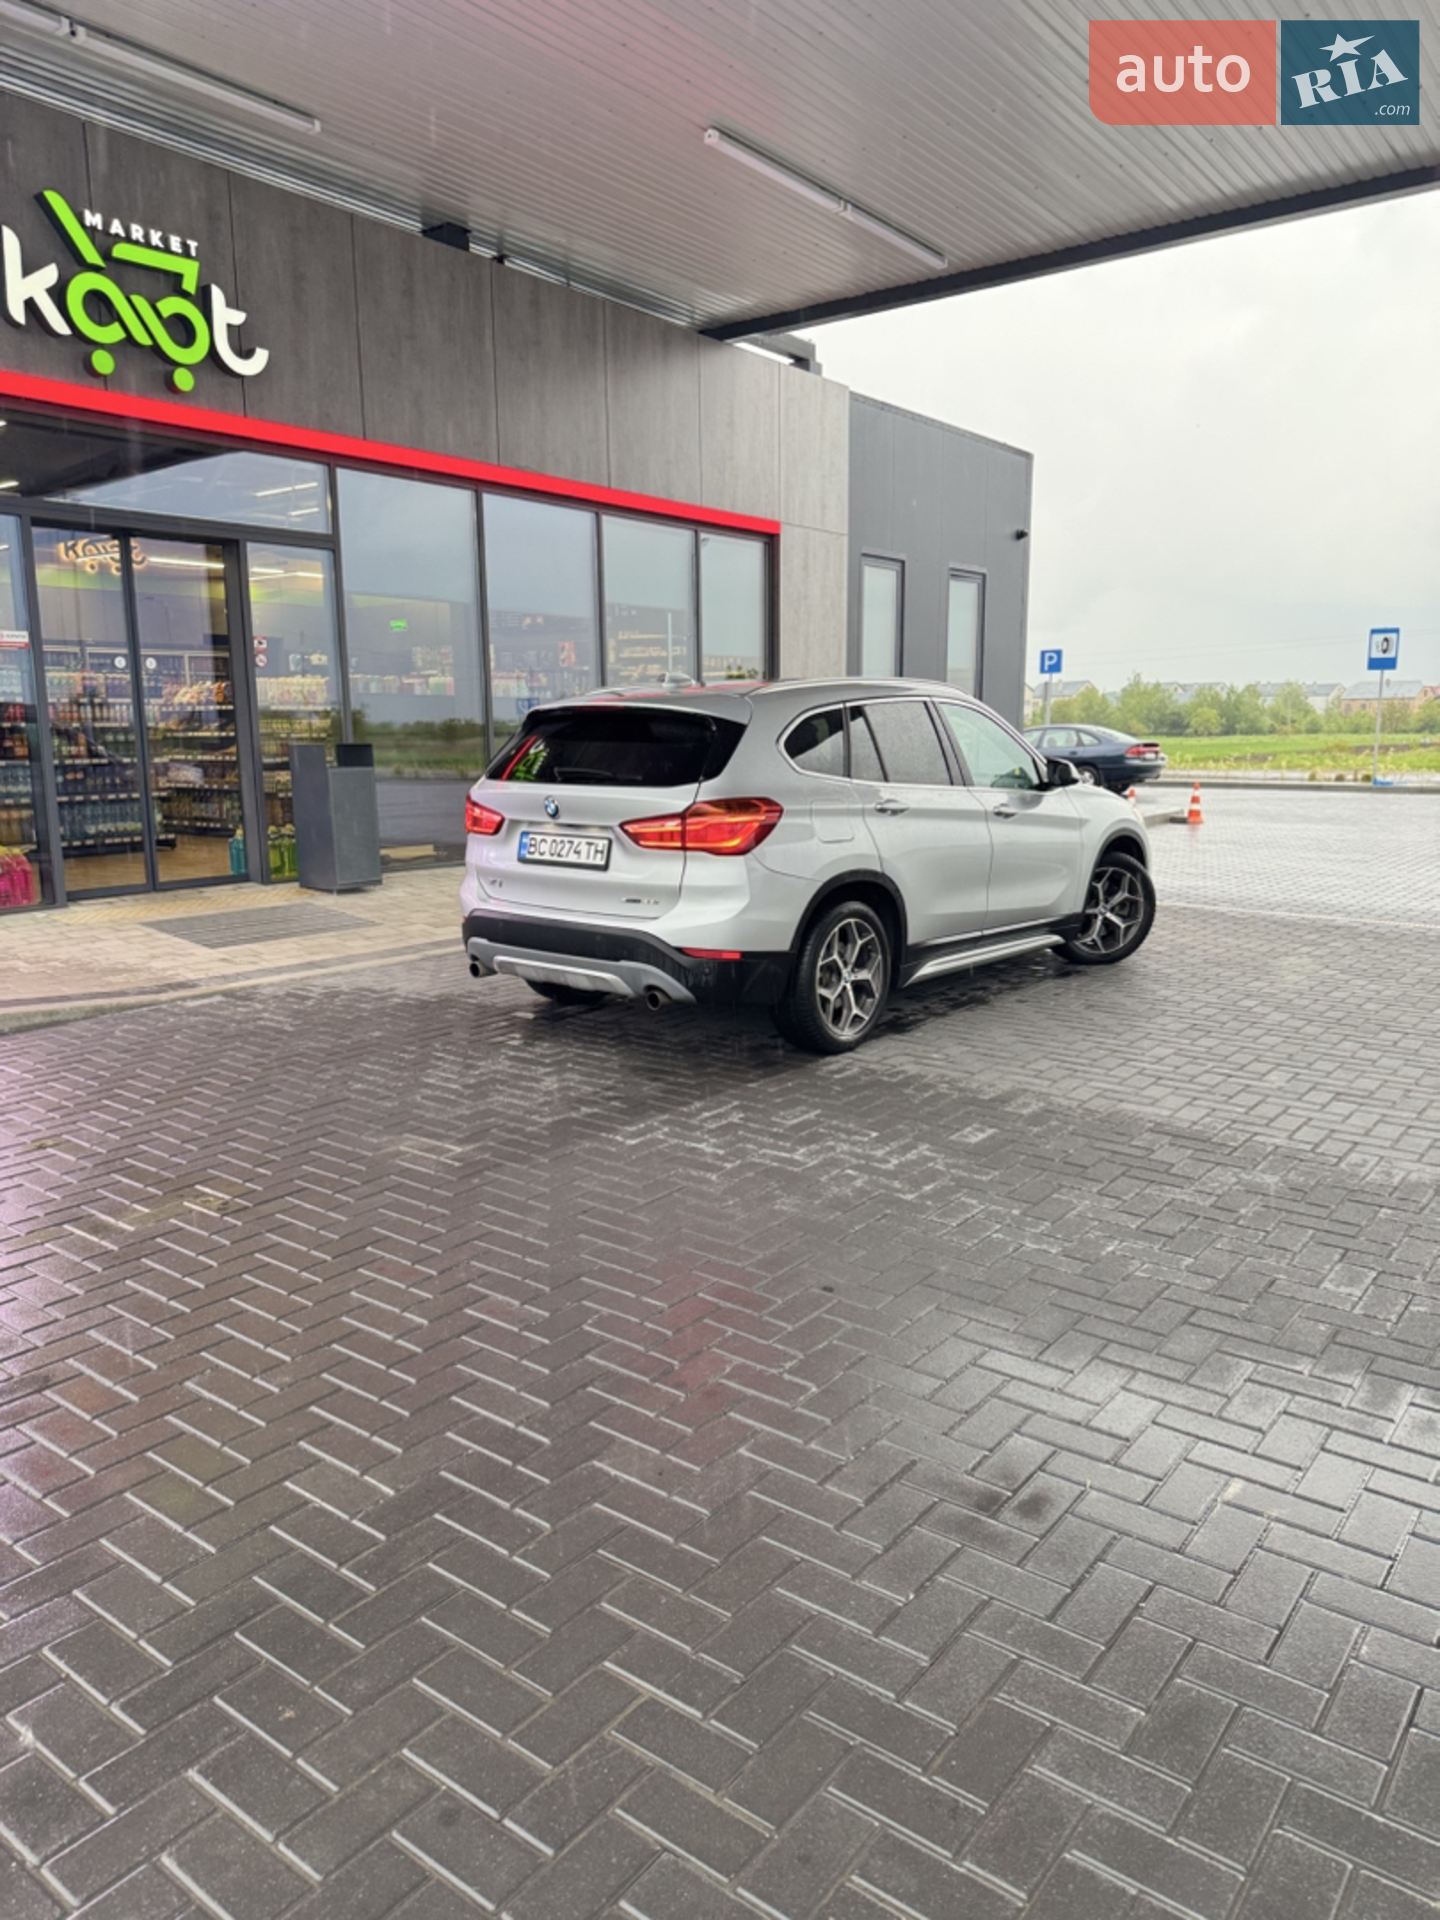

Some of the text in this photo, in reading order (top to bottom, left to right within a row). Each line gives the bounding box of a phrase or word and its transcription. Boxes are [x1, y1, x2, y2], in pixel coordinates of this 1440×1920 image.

[83, 208, 199, 257] MARKET
[1044, 651, 1059, 671] P
[527, 836, 606, 862] BC 0274 TH
